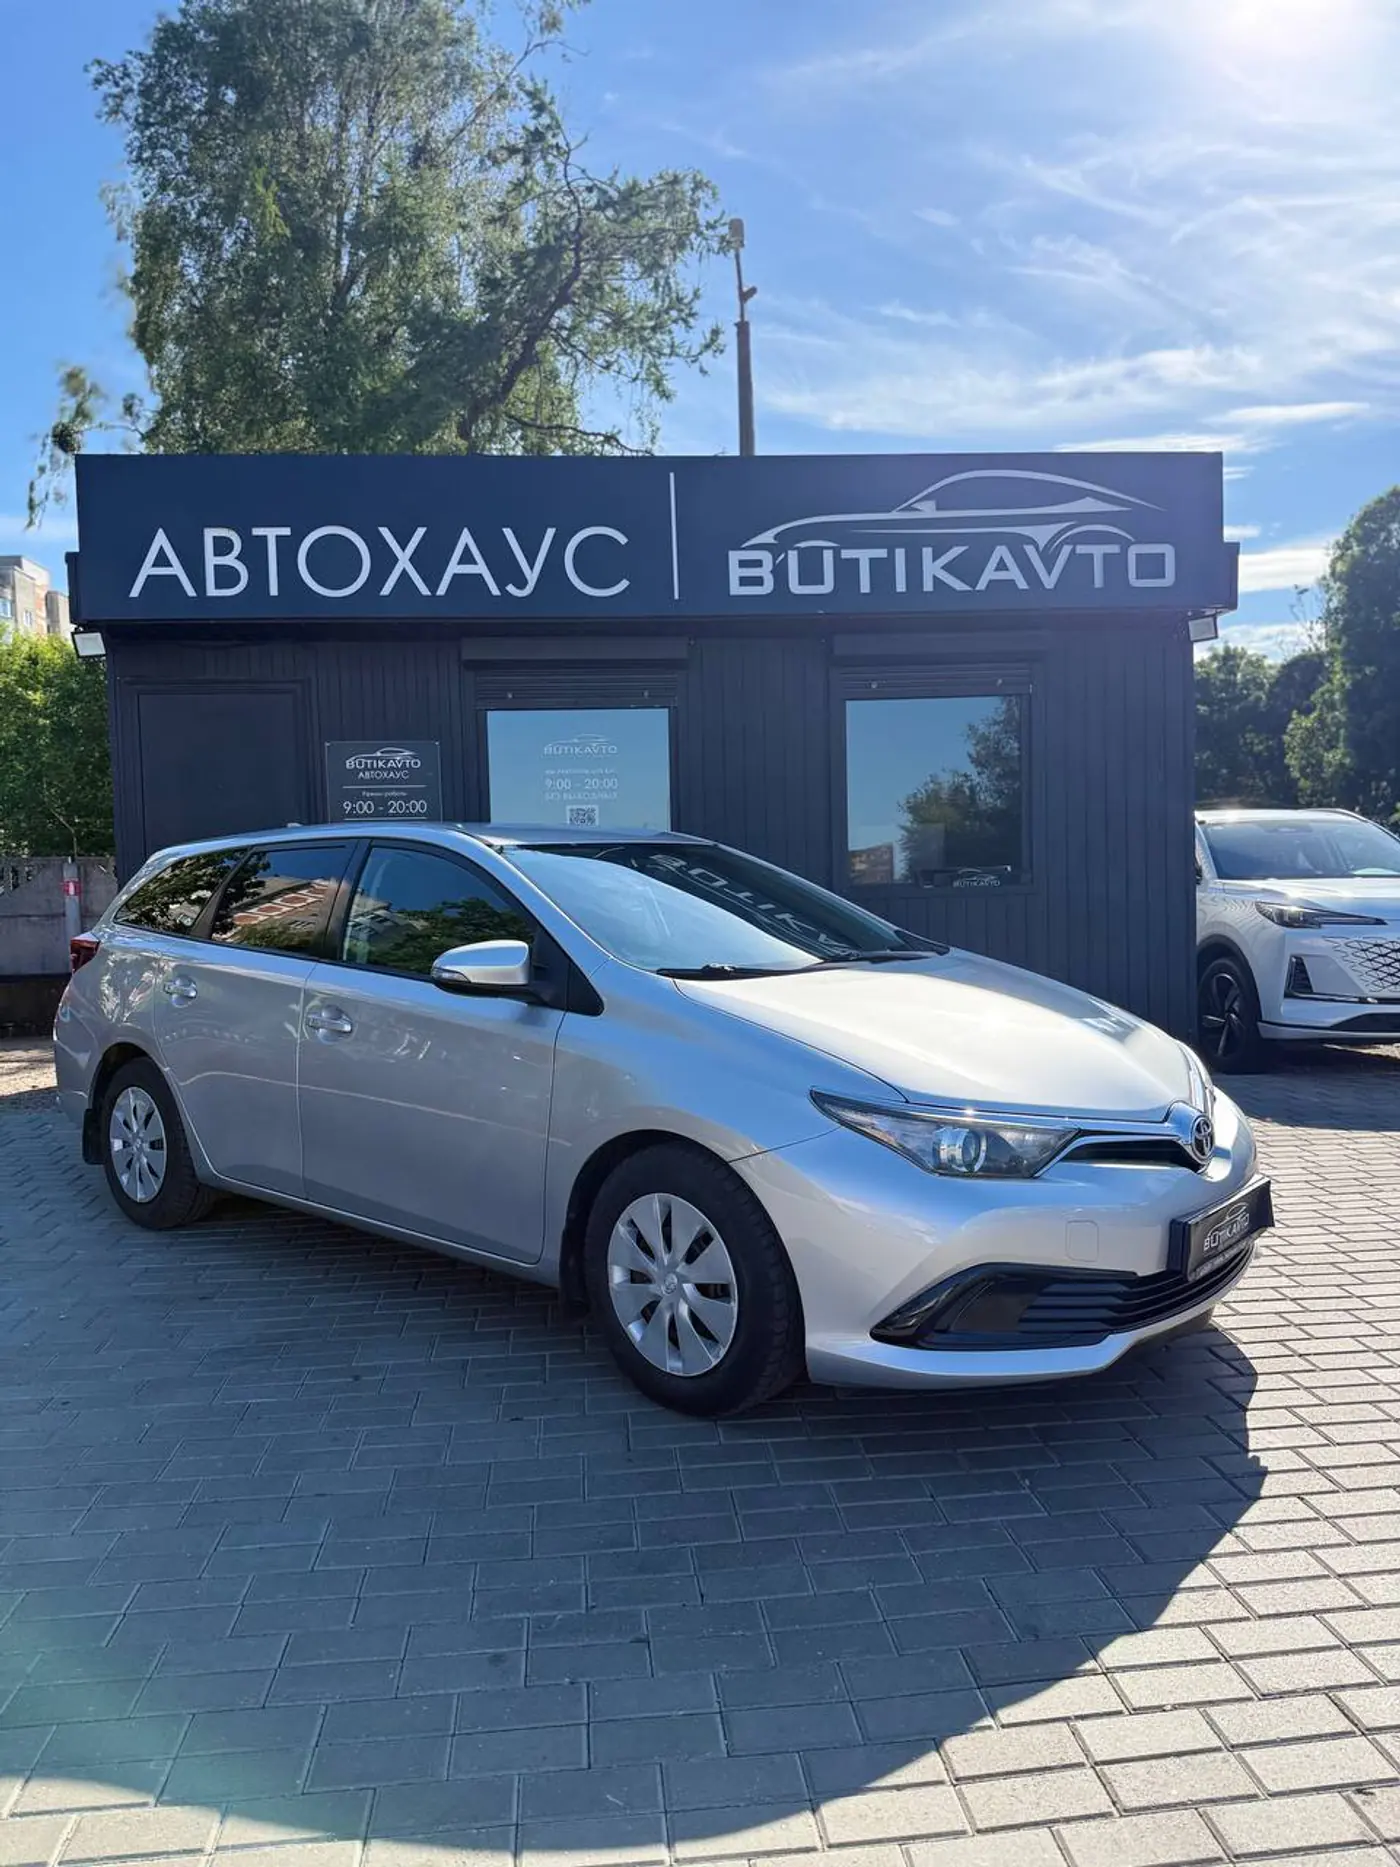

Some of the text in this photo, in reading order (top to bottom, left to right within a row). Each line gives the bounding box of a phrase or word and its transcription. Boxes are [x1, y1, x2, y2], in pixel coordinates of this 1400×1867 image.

[129, 525, 630, 598] АВТОХАУС
[728, 542, 1176, 596] BUTIKAVTO
[345, 759, 421, 769] BUTIKAVTO
[358, 771, 410, 779] АВТОХАУС
[545, 778, 572, 790] 9:00
[585, 778, 618, 789] 20:00
[343, 801, 374, 814] 9:00
[388, 800, 427, 813] 20:00
